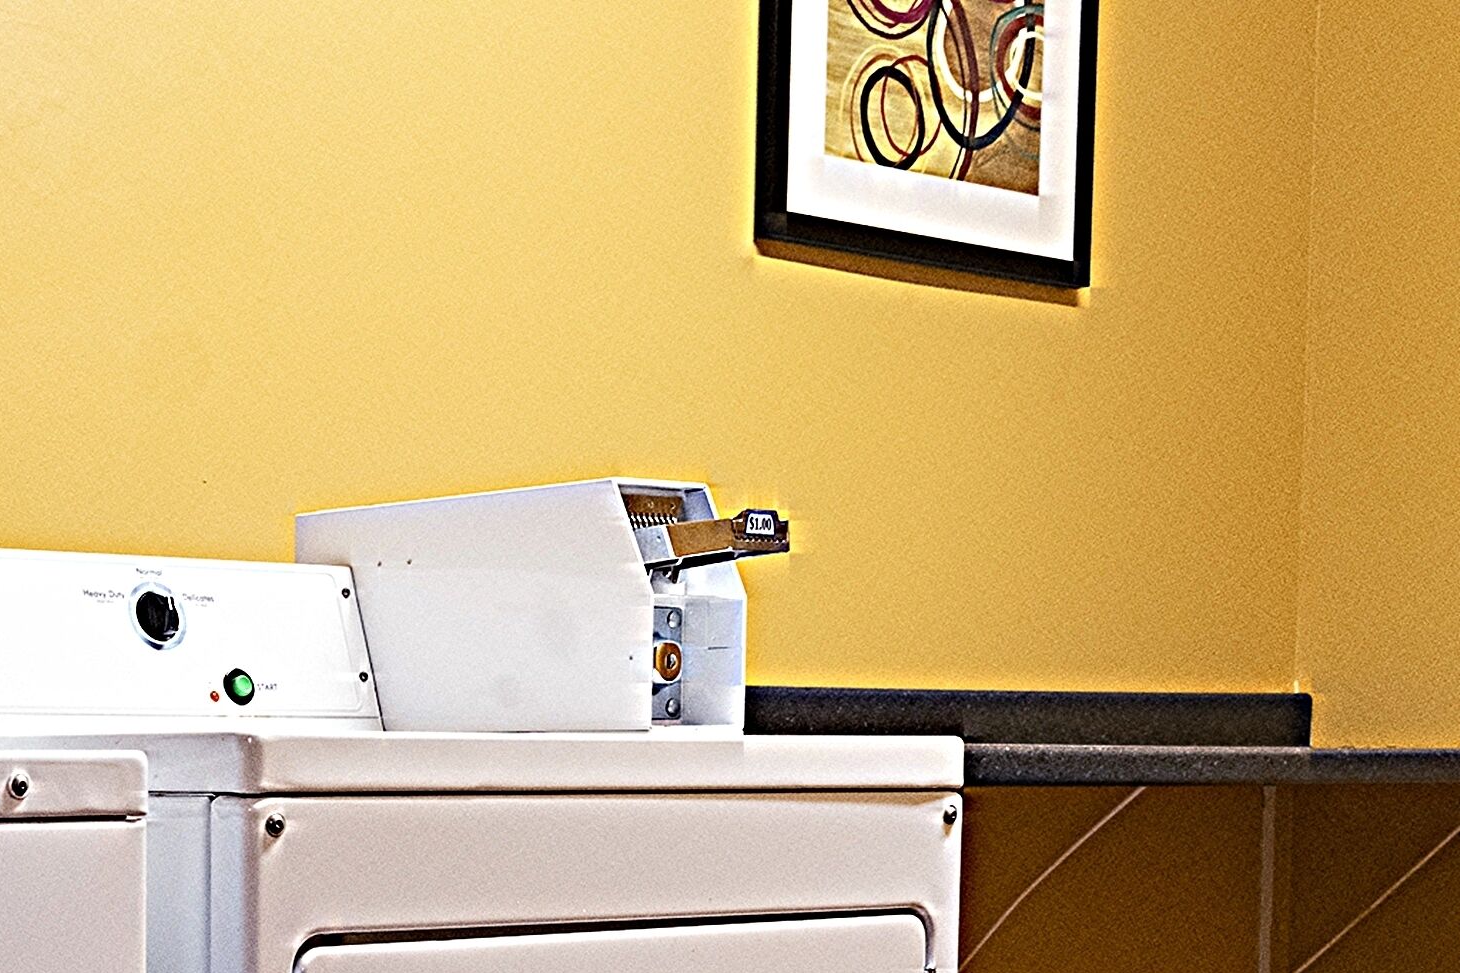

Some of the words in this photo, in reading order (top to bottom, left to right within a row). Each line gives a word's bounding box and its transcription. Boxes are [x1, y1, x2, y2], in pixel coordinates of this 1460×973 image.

[749, 516, 772, 531] $1.00
[83, 589, 106, 598] Heavy
[108, 590, 125, 599] Duty
